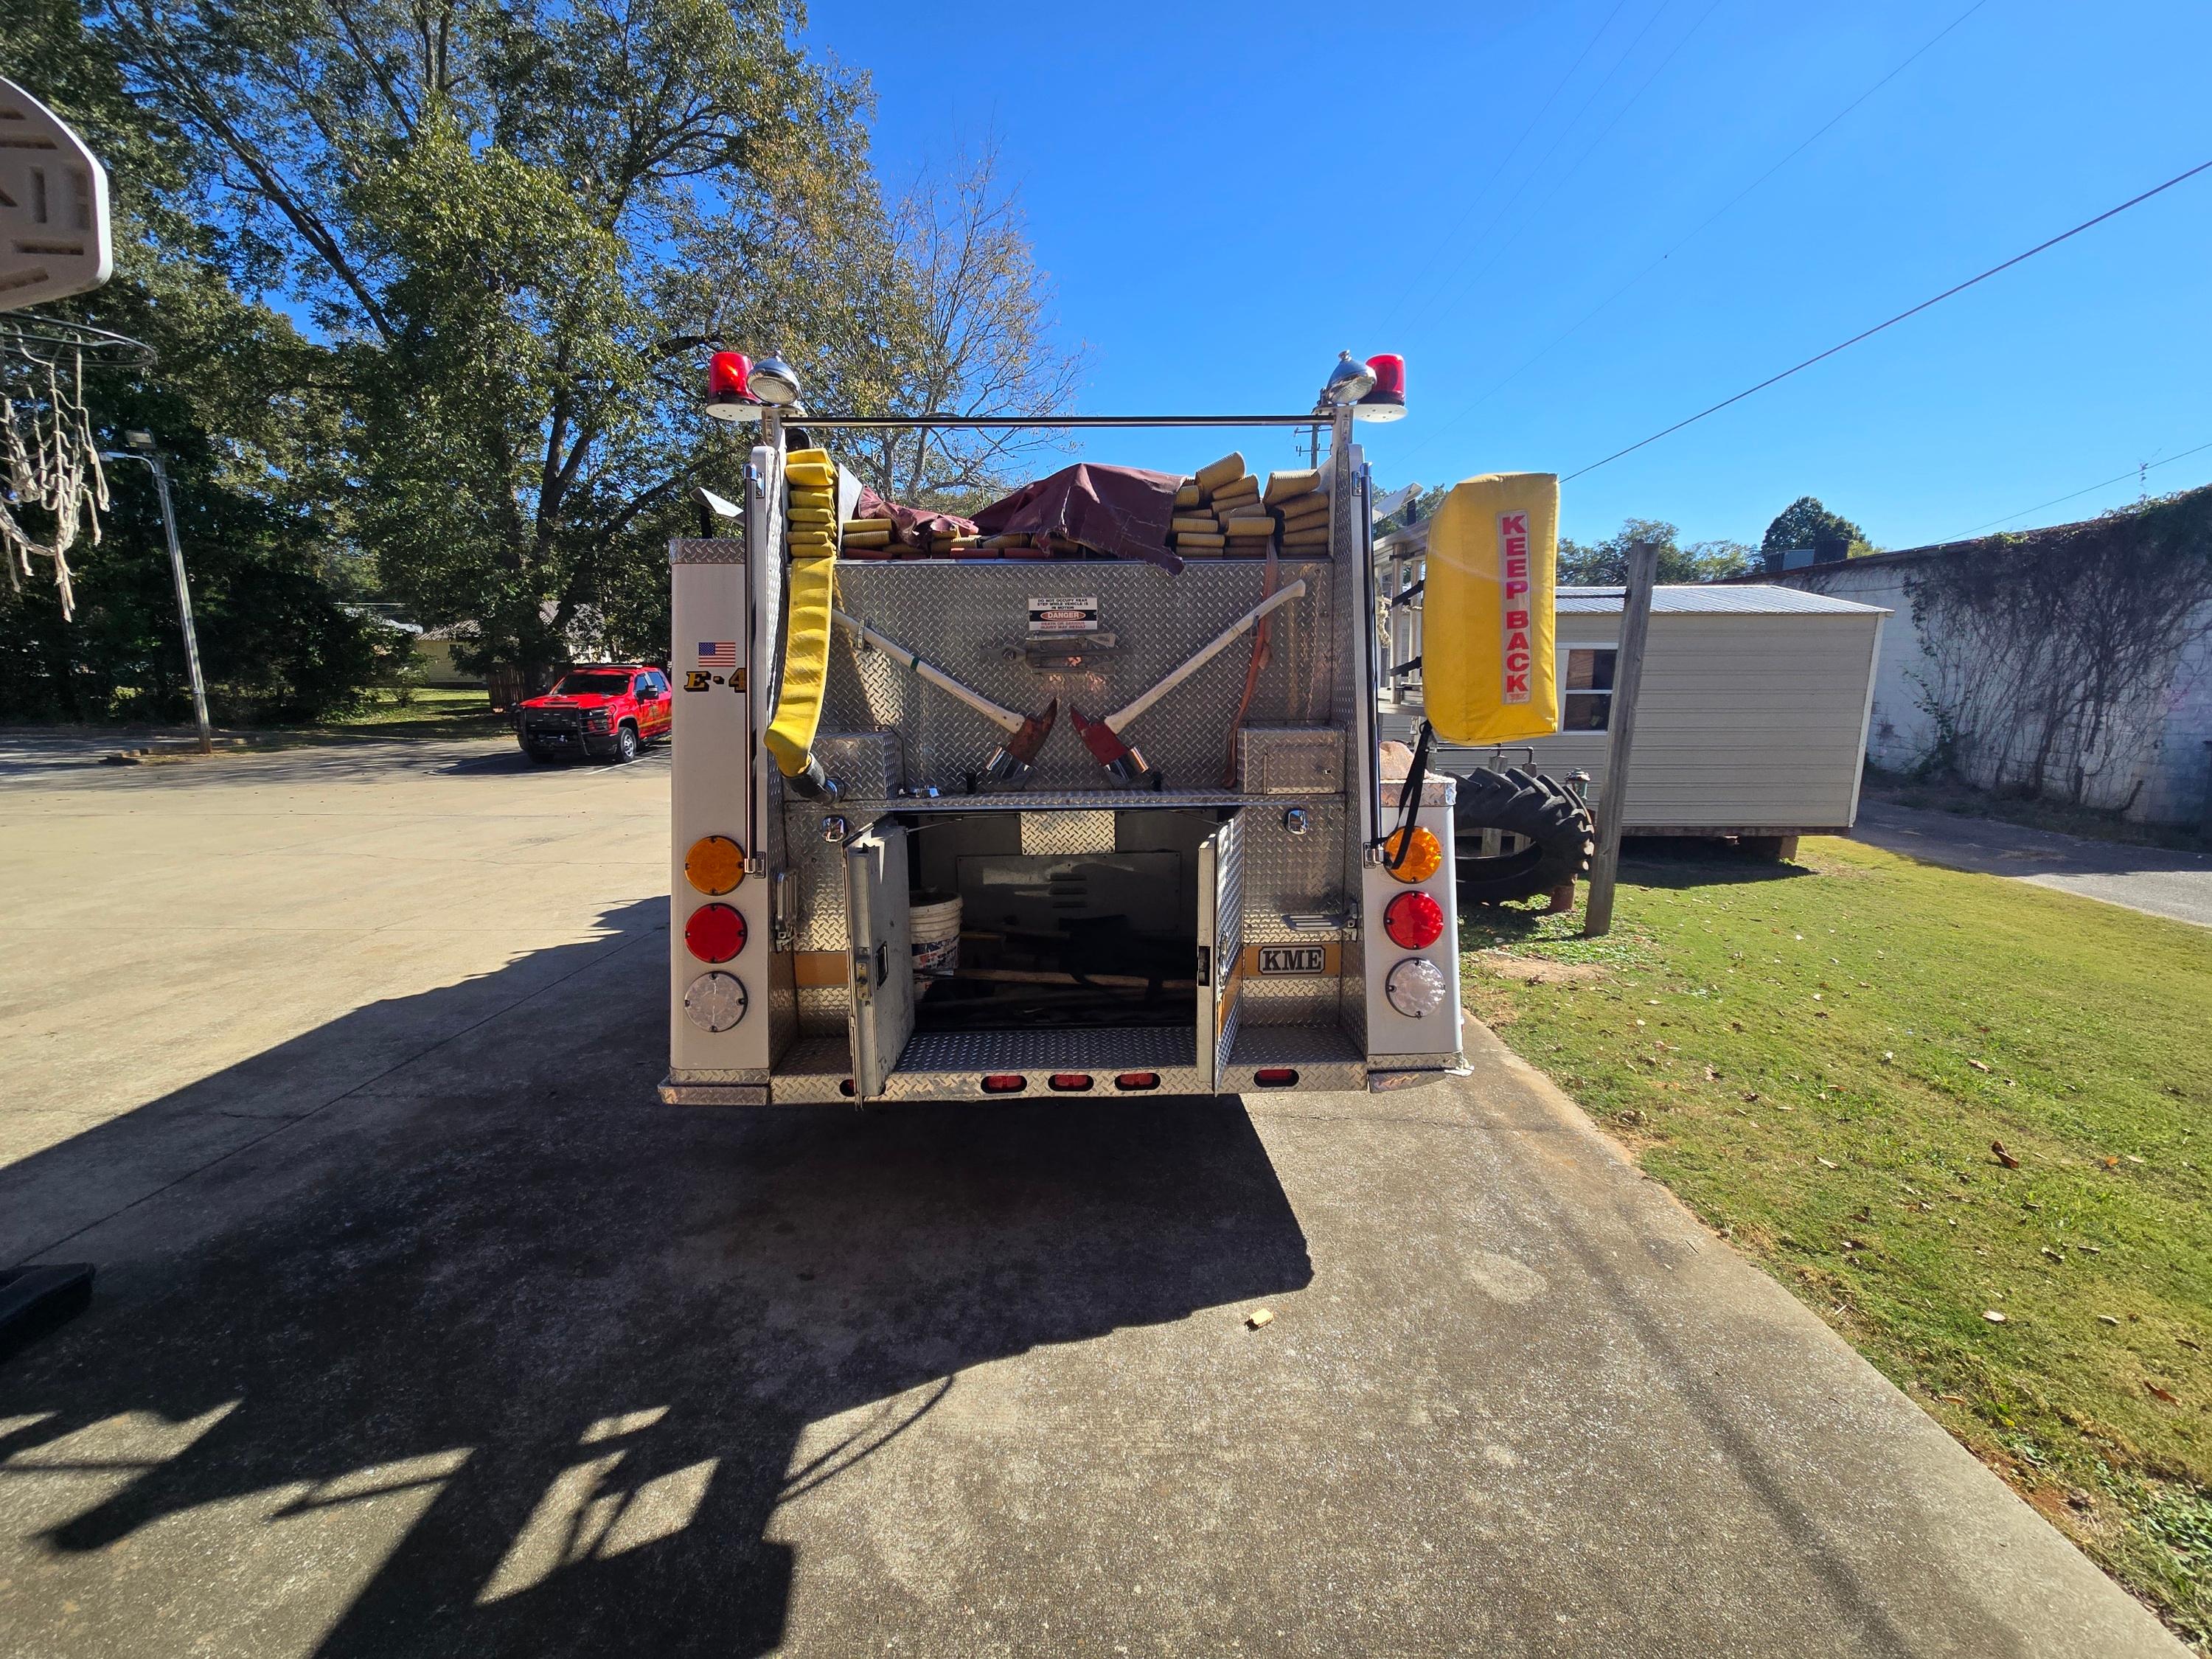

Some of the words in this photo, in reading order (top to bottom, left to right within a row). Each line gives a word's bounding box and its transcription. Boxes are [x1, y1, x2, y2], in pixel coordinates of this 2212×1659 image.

[1502, 515, 1529, 599] KEEP
[1506, 611, 1530, 692] BACK
[684, 667, 746, 693] E-4
[1263, 950, 1322, 971] KME
